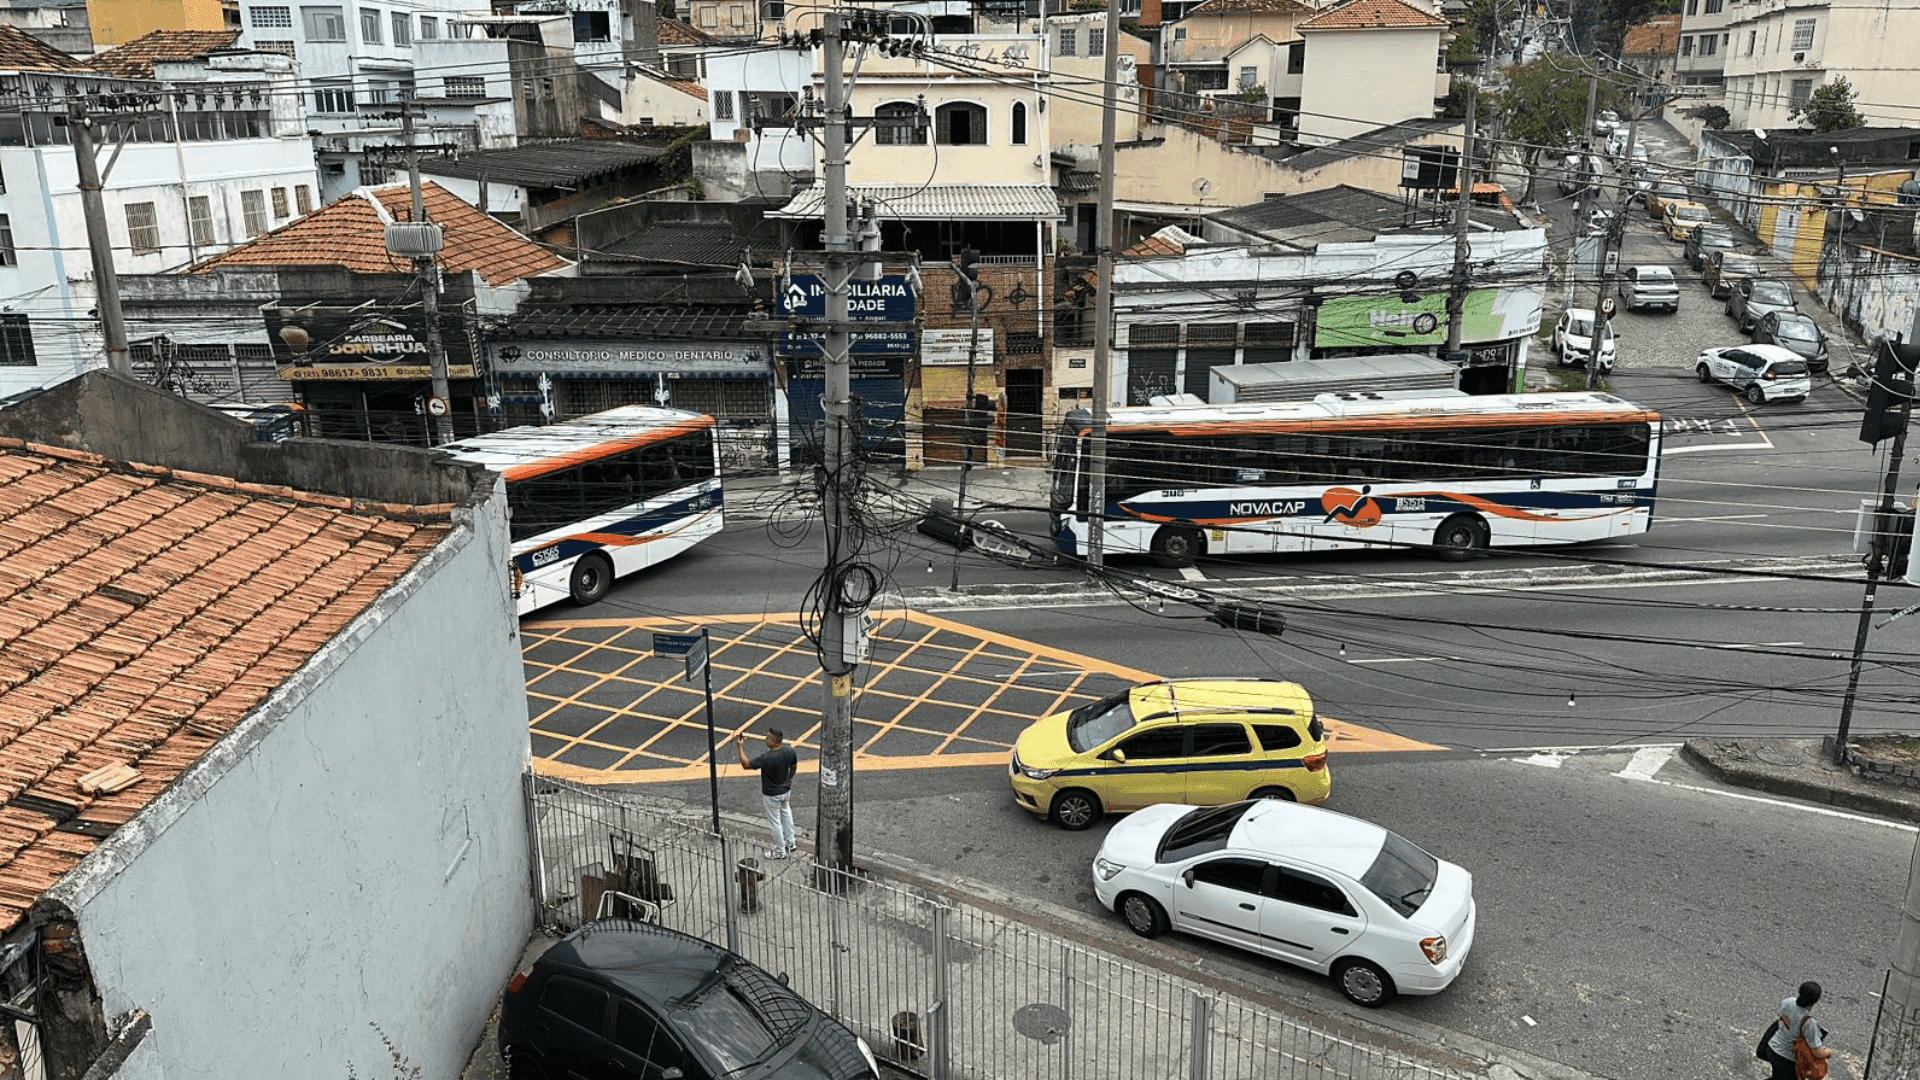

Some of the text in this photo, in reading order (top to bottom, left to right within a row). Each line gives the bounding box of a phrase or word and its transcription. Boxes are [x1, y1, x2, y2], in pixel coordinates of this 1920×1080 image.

[846, 299, 886, 311] DADE
[619, 350, 666, 361] MEDICO
[675, 350, 733, 361] DENTARIO
[1230, 501, 1306, 515] NOVACAP
